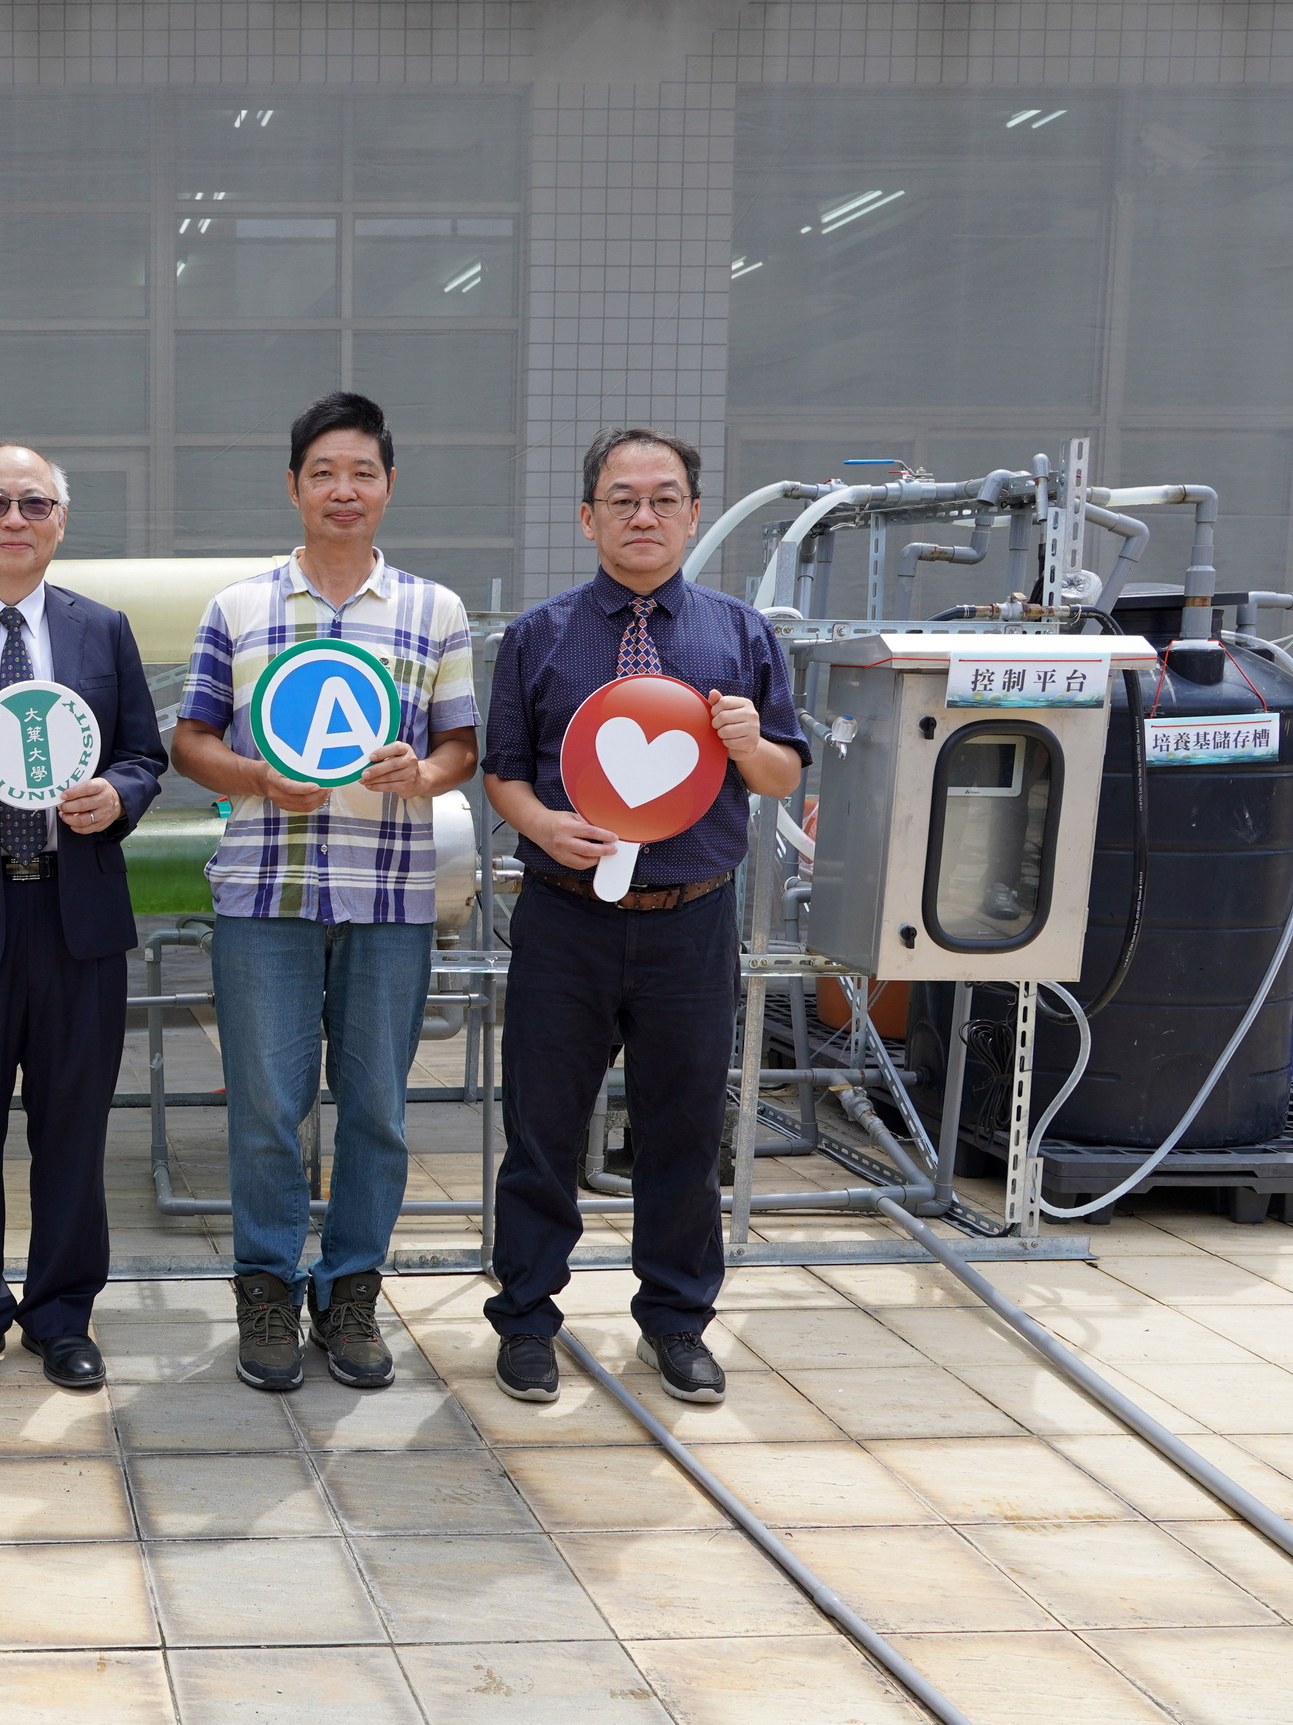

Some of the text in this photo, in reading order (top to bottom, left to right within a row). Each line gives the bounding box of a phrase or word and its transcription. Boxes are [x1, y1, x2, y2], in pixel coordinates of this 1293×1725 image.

[971, 668, 1087, 693] 控制平台
[7, 700, 94, 801] UNIVERSITY
[23, 707, 48, 783] 大葉大學
[1152, 728, 1270, 753] 培養基儲存槽
